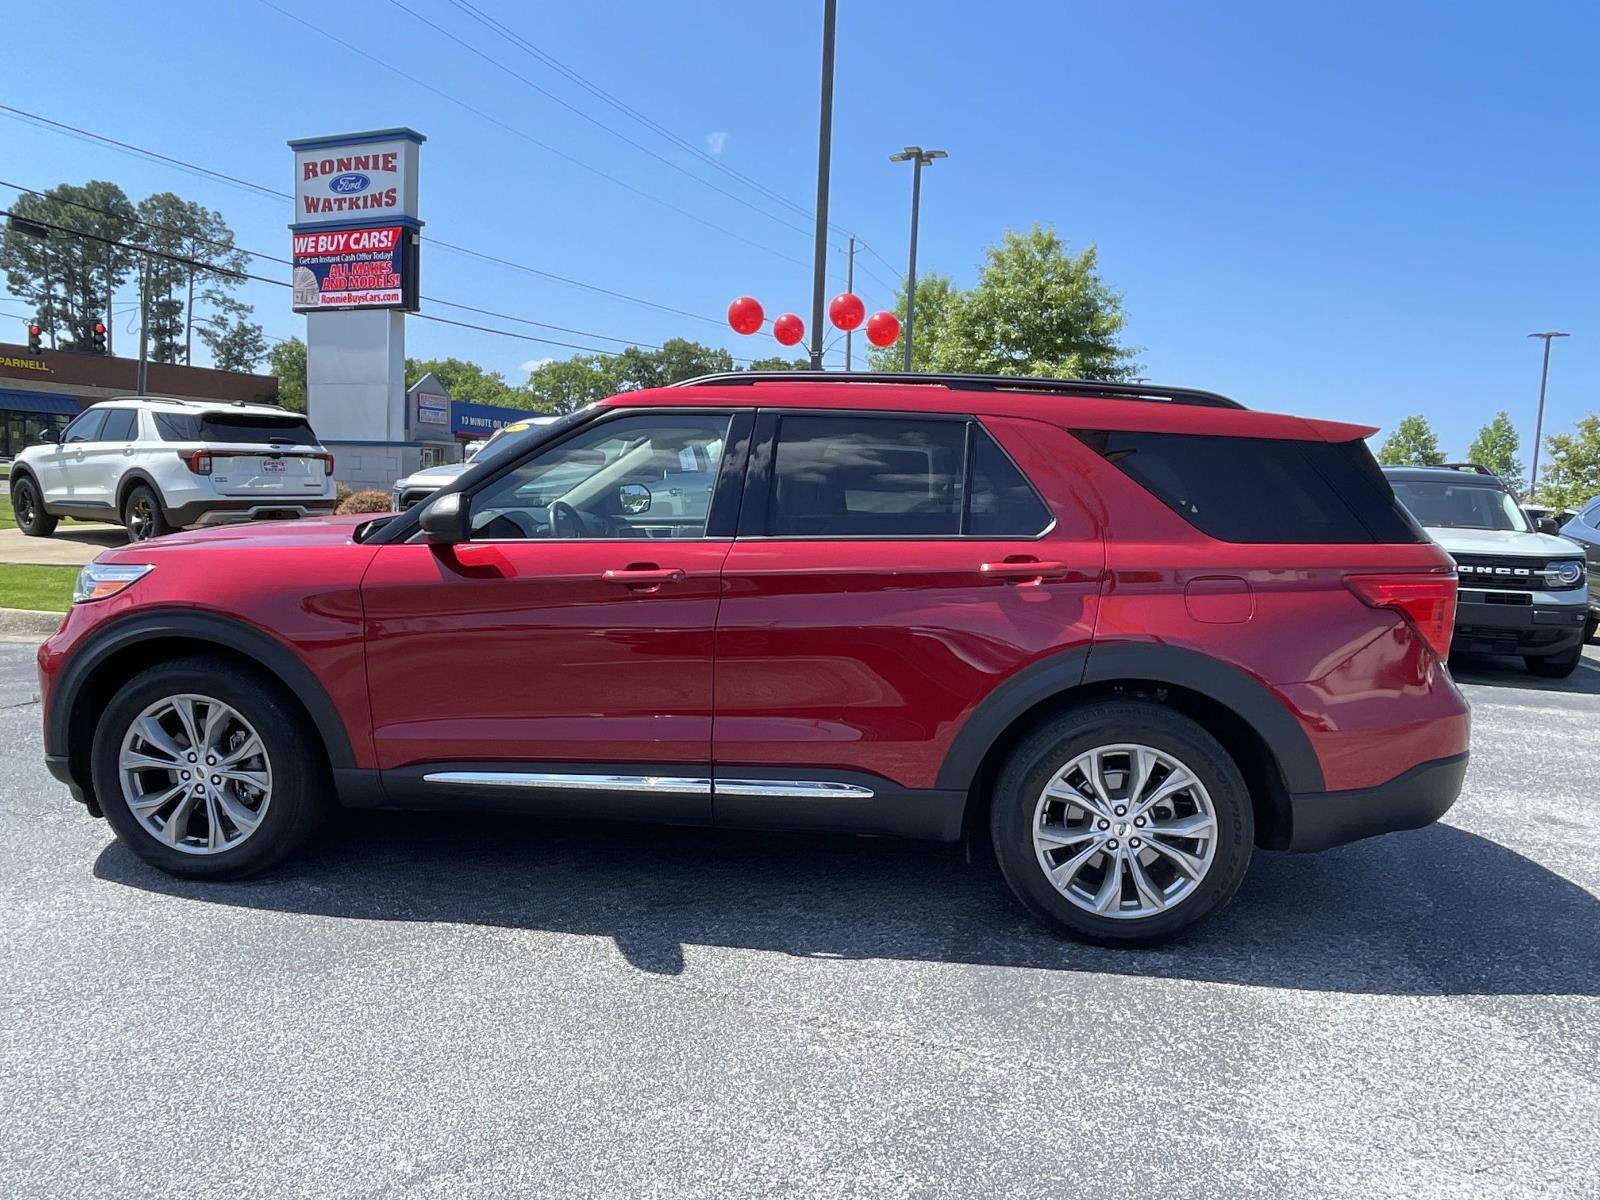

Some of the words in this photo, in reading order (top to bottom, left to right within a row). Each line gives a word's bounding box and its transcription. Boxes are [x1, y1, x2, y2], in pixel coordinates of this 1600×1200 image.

[303, 152, 398, 181] RONNIE
[336, 176, 362, 192] Ford
[303, 187, 397, 214] WATKINS
[294, 236, 316, 253] WE
[318, 233, 348, 252] BUY
[349, 230, 393, 249] CARS!
[299, 257, 310, 265] Get
[320, 254, 340, 263] Instant
[341, 253, 356, 262] Cash
[356, 252, 372, 261] Offer
[373, 251, 393, 261] Today!
[329, 263, 350, 278] ALL
[351, 261, 393, 276] MAKES
[321, 277, 347, 291] AND
[348, 273, 401, 290] MODELS!
[321, 292, 399, 304] RonnieBuysCars.com
[0, 357, 50, 371] PARNELL
[469, 416, 492, 428] MINUTE
[1452, 565, 1530, 576] ONCO
